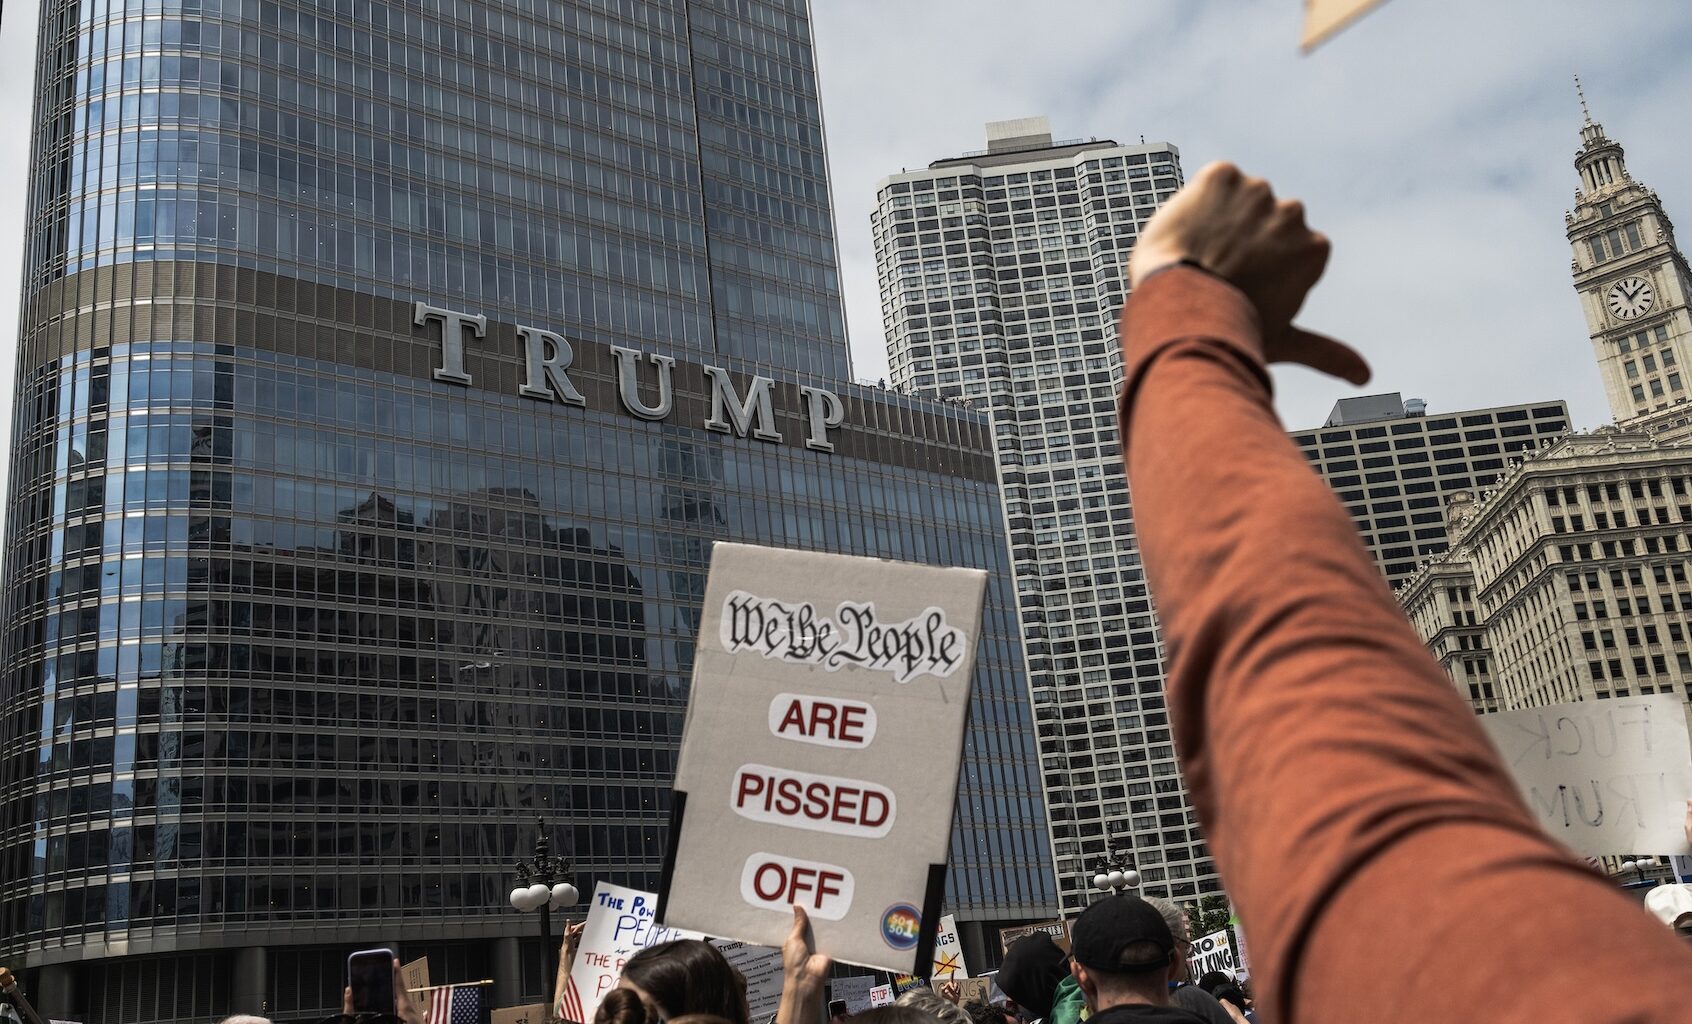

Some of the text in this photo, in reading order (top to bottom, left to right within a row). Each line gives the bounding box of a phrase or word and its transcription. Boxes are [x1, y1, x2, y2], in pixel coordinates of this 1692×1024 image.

[413, 301, 845, 453] TRUMP
[728, 596, 961, 680] We the People
[778, 699, 867, 743] ARE
[737, 772, 890, 828] PISSED
[754, 862, 844, 909] OFF
[598, 892, 655, 918] THE POW
[718, 941, 743, 953] Trump
[935, 933, 955, 947] NGS
[585, 952, 610, 968] THE
[1205, 948, 1233, 973] KING
[872, 988, 887, 1001] STOP
